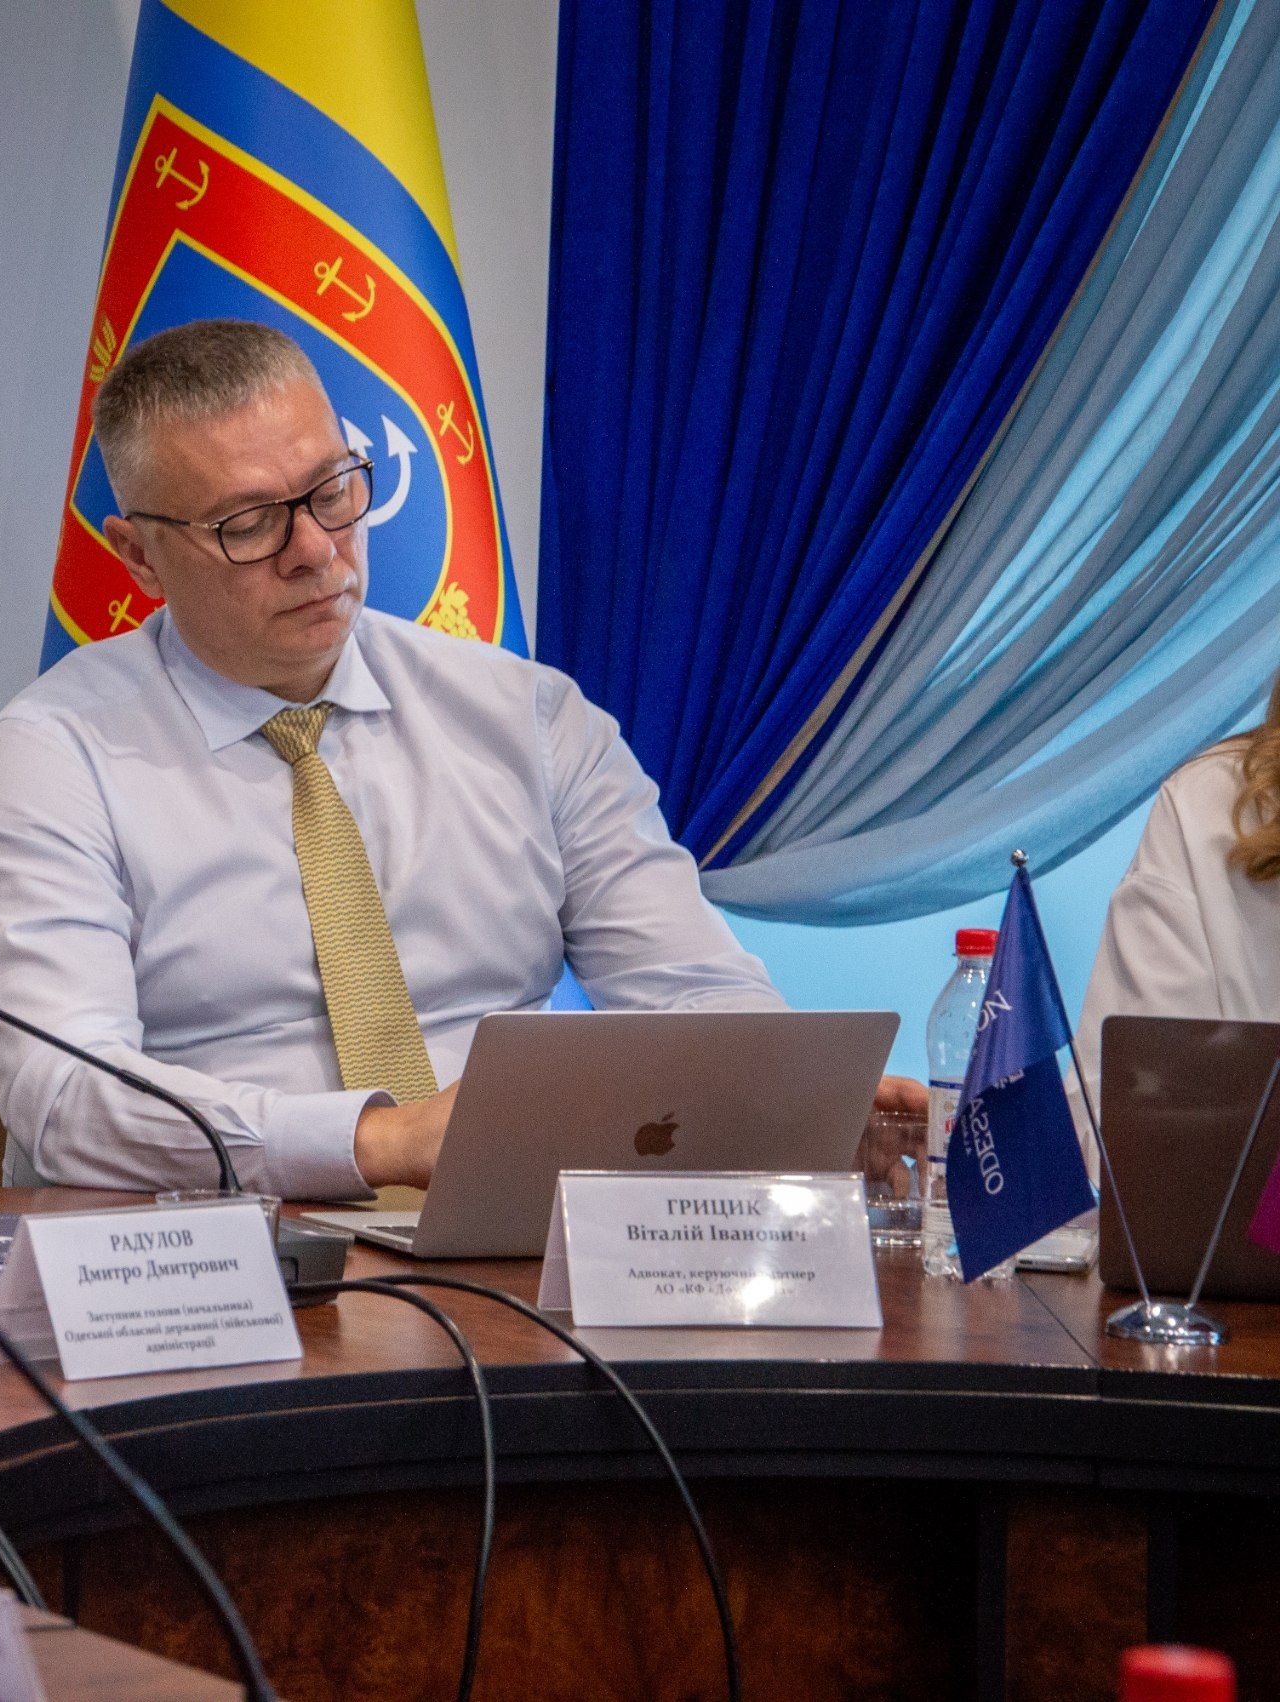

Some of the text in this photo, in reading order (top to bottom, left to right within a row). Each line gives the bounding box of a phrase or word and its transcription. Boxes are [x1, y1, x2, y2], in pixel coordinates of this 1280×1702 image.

[667, 1199, 761, 1218] ГРИЦИК
[110, 1230, 193, 1252] РАДУЛОВ
[627, 1224, 807, 1242] Віталій Іванович
[79, 1257, 238, 1285] Дмитро Дмитрович
[628, 1268, 687, 1280] Адвокат,
